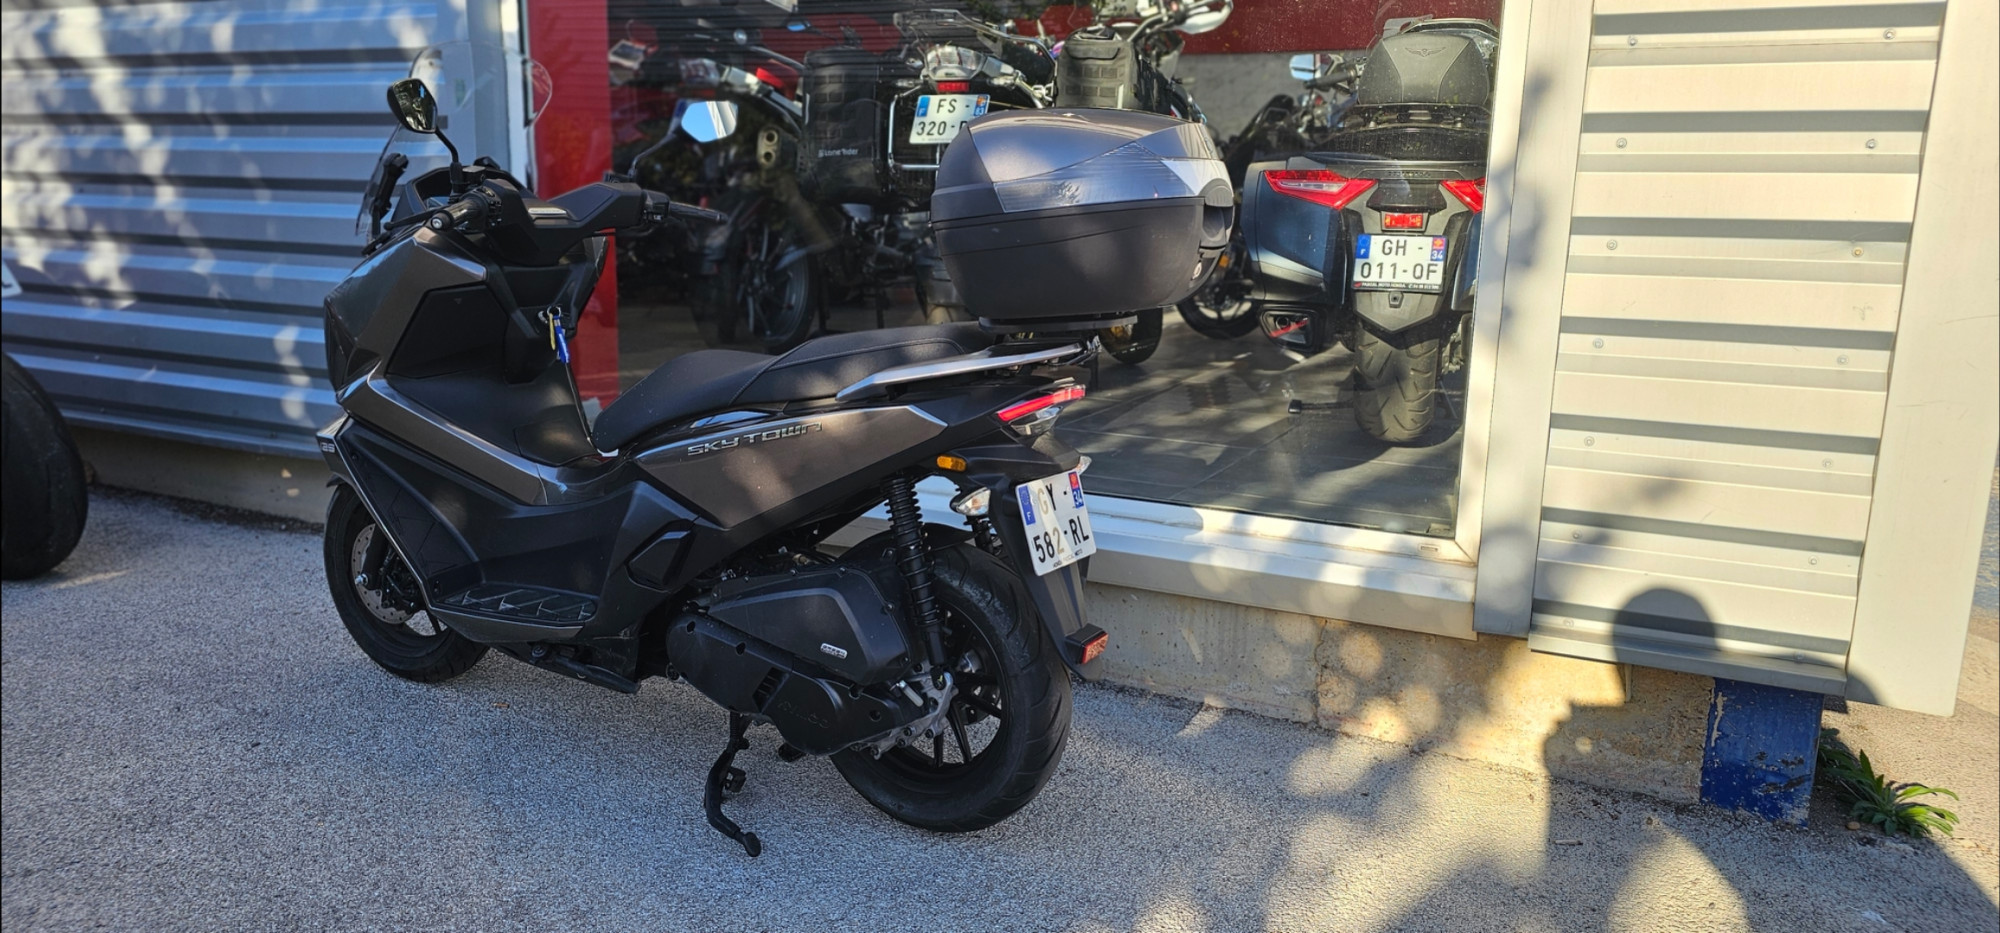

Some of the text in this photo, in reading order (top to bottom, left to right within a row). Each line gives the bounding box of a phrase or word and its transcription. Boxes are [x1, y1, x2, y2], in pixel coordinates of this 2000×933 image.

[936, 98, 957, 114] FS
[1360, 248, 1366, 256] F
[1382, 239, 1407, 256] GH
[1431, 250, 1443, 260] 34
[687, 421, 823, 457] SKY TOWN
[1037, 483, 1057, 515] GY
[1073, 490, 1083, 506] 34
[1032, 515, 1090, 563] 582-RL
